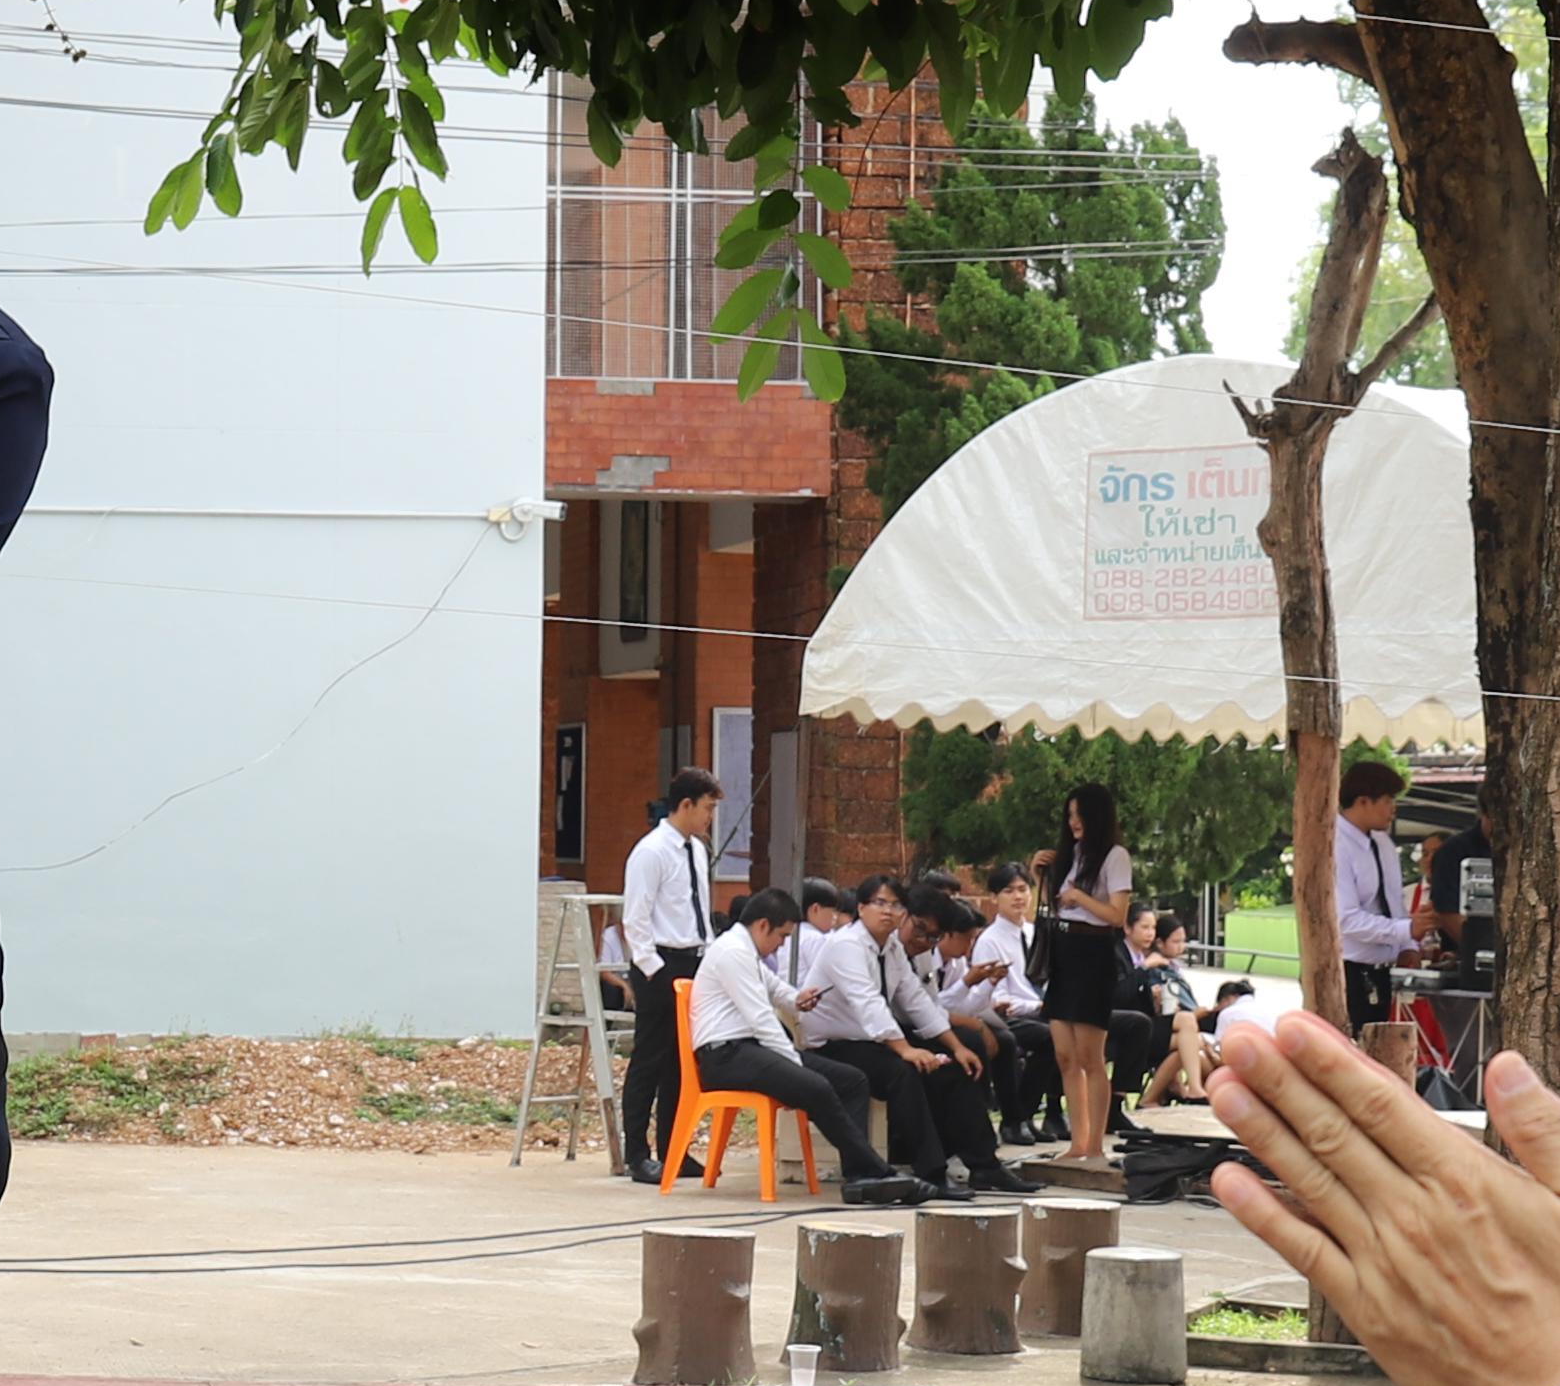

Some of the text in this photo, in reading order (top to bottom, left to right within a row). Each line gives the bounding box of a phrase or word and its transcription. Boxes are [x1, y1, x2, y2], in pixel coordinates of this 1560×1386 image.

[1099, 466, 1175, 503] จักร
[1138, 505, 1236, 537] ให้เช่า
